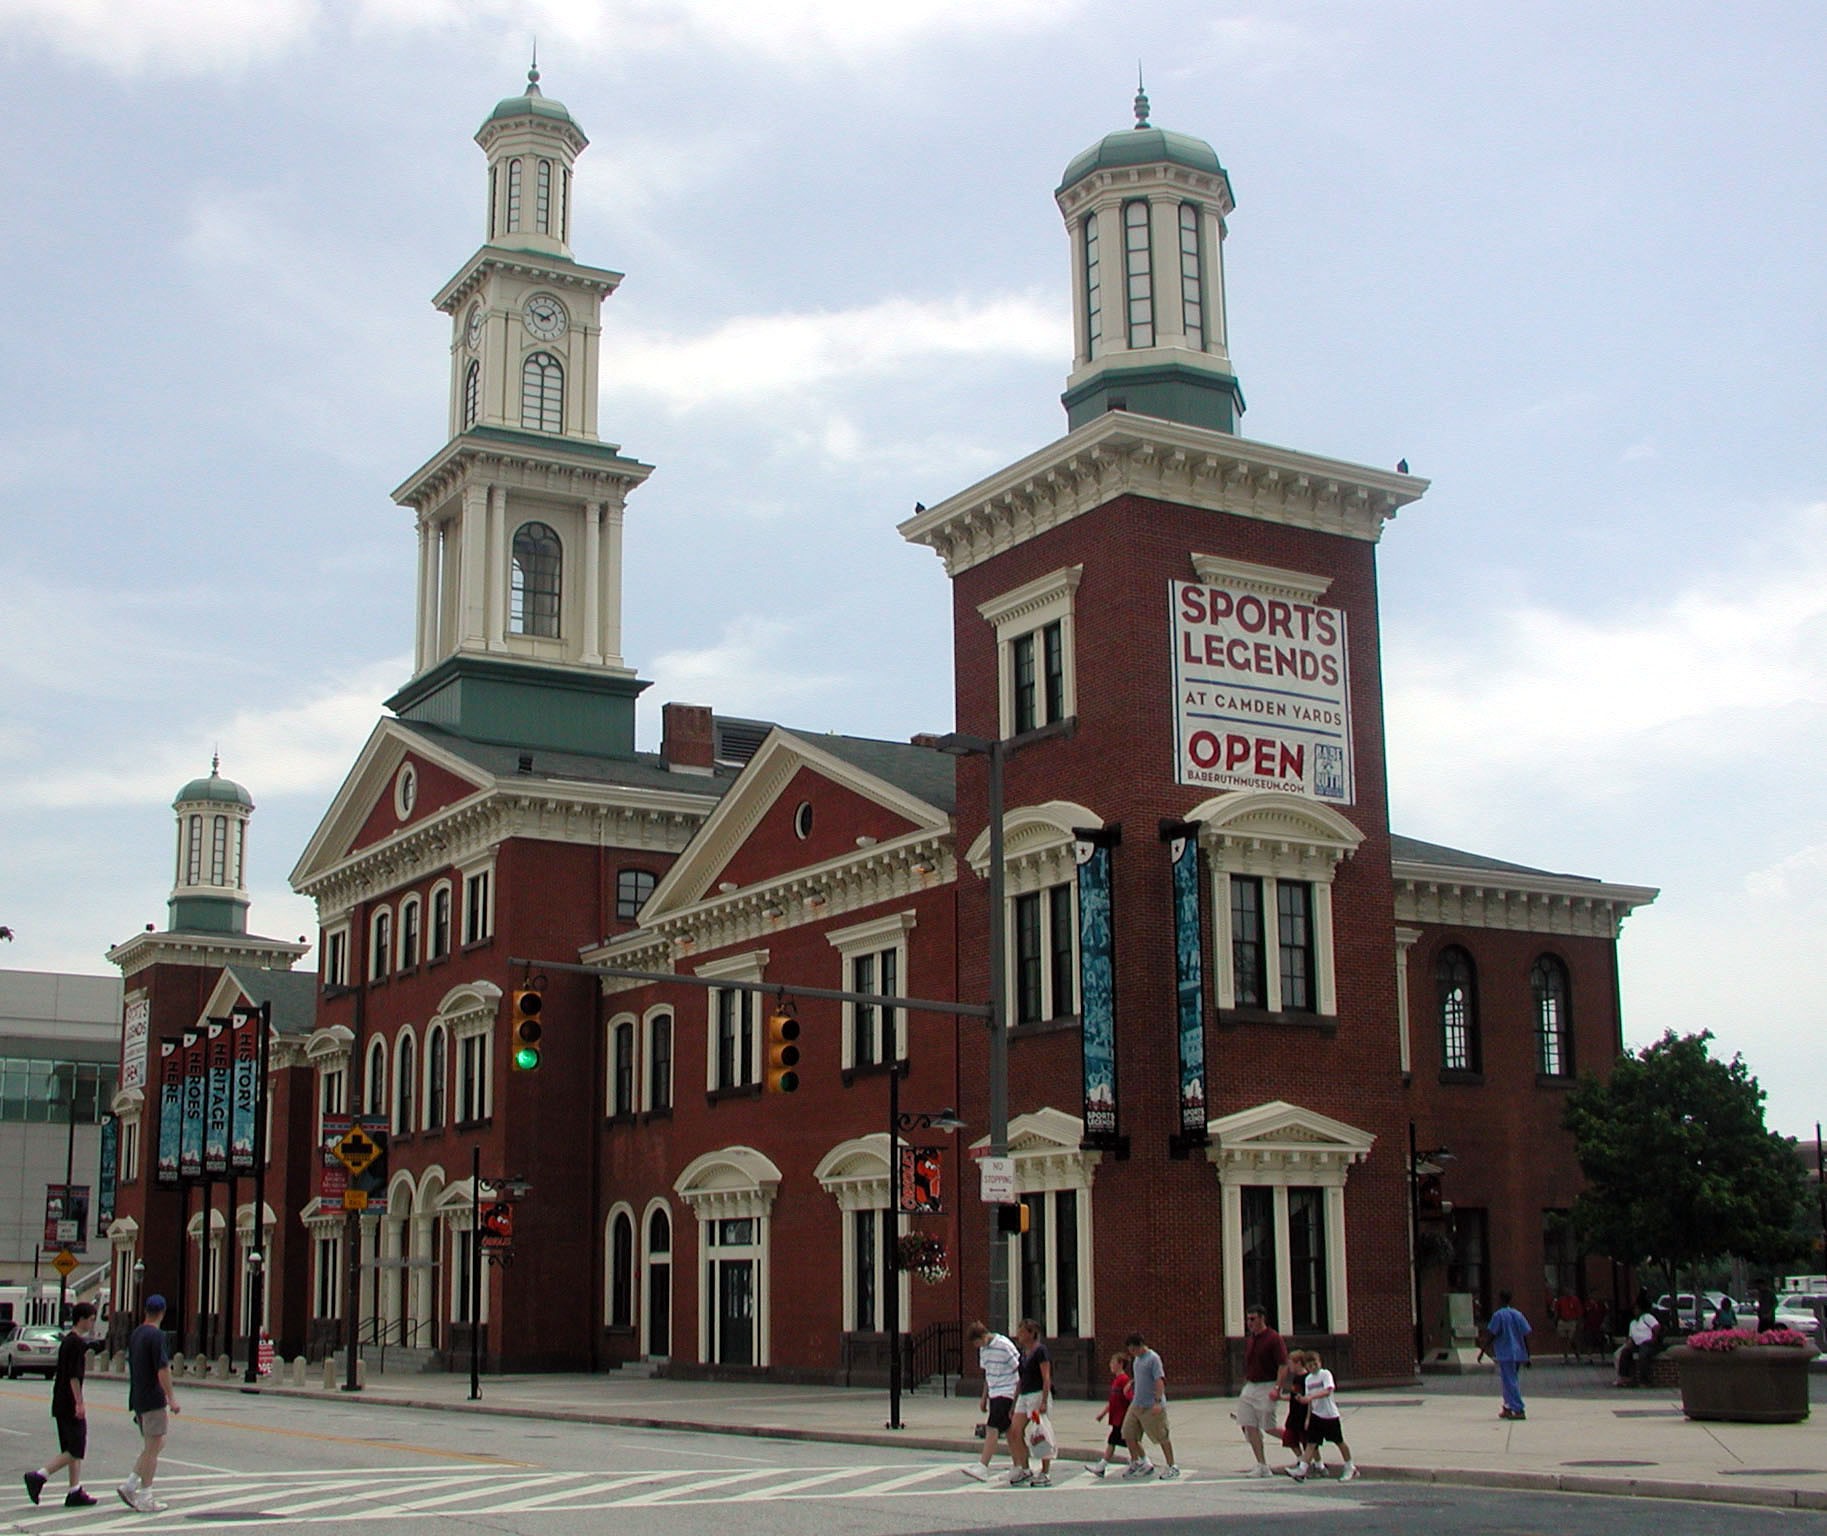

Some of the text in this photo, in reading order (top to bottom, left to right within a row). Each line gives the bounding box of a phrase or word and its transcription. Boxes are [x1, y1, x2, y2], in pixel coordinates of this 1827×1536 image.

[1181, 585, 1337, 646] SPORTS
[1184, 630, 1339, 686] LEGENDS
[1185, 691, 1342, 726] AT CAMDEN YARDS
[1187, 769, 1305, 793] BABERUTHMUSEUM.COM
[1188, 730, 1305, 781] OPEN
[166, 1061, 178, 1104] HERE
[187, 1052, 201, 1119] HEROES
[211, 1043, 228, 1131] HERITAGE
[238, 1033, 253, 1112] HISTORY
[992, 1162, 1004, 1171] NO
